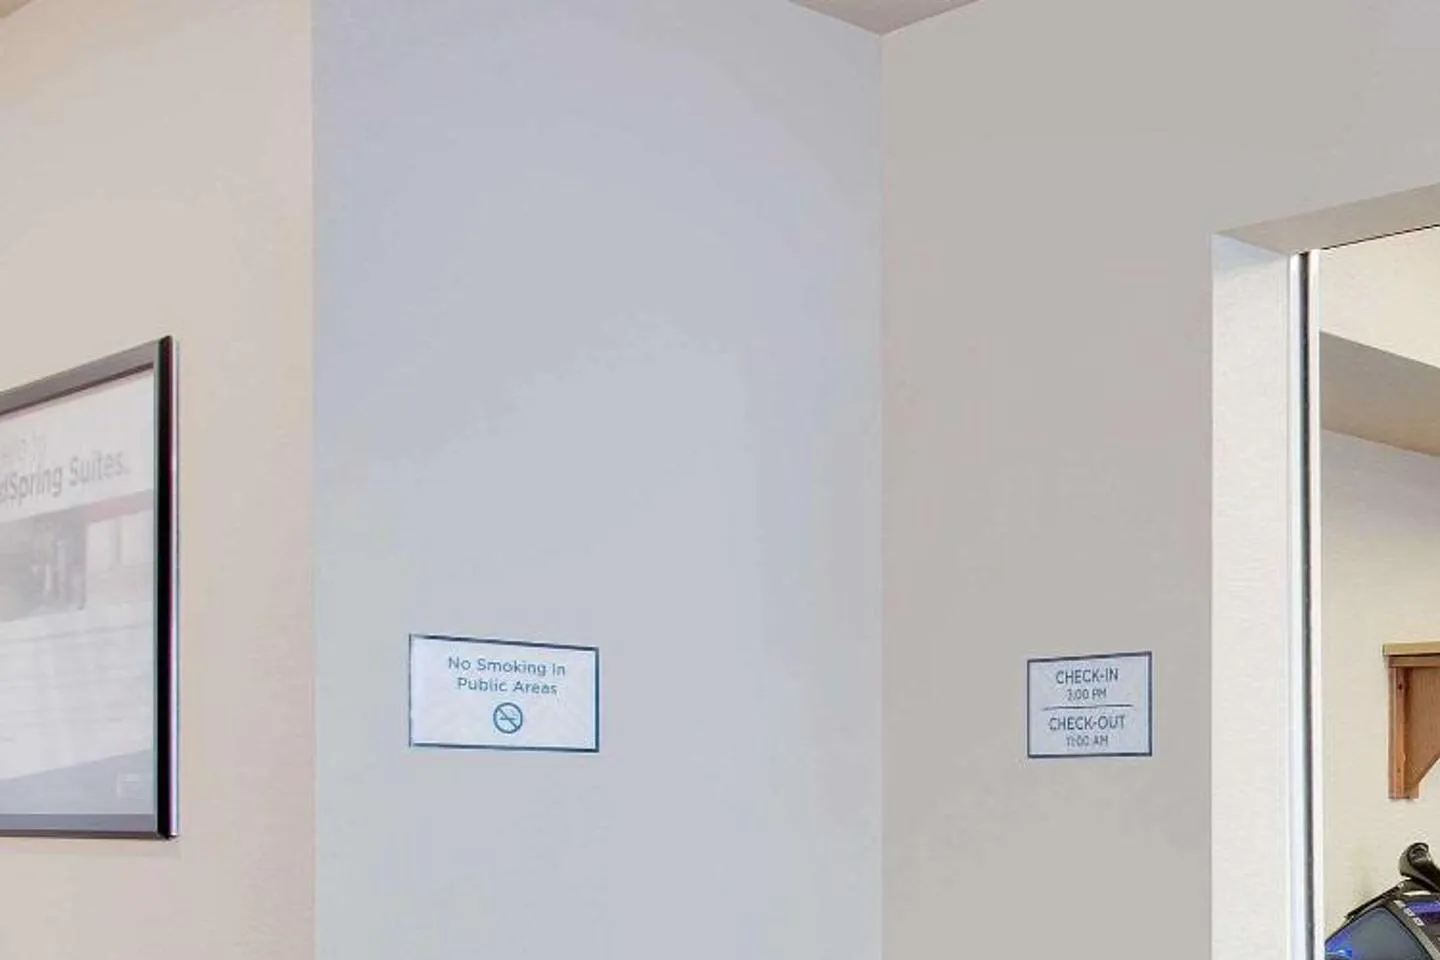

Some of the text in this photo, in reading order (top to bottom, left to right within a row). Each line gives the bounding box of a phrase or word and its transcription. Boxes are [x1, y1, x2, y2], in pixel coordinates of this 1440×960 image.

[448, 656, 566, 676] No Smoking In
[1056, 668, 1118, 685] CHECK-IN
[457, 677, 557, 694] Public Areas
[1092, 688, 1107, 700] PM
[1048, 715, 1125, 731] CHECK-OUT
[1093, 735, 1109, 747] AM
